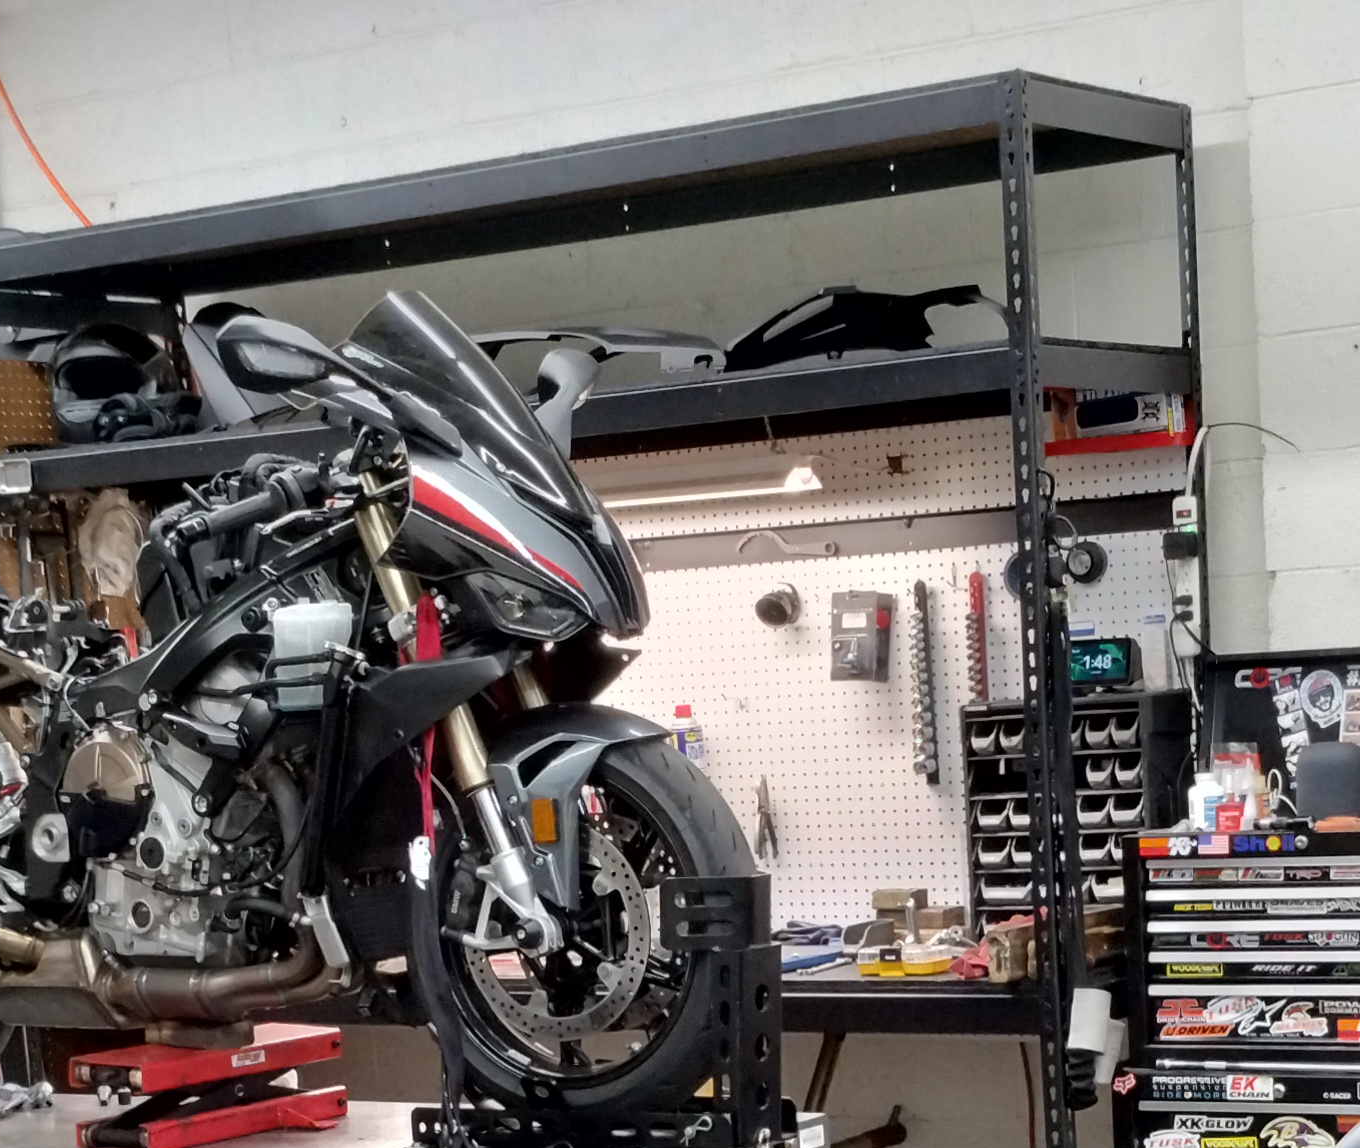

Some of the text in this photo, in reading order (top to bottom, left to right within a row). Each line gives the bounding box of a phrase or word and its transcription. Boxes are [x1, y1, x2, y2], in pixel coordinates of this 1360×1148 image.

[1083, 654, 1112, 669] 1:48
[1252, 964, 1318, 972] RIDE IT
[1177, 1025, 1229, 1035] DRIVEN
[1152, 1076, 1227, 1084] PROGRESSIVE
[1230, 1076, 1258, 1090] EK
[1147, 1138, 1195, 1148] TUSK
